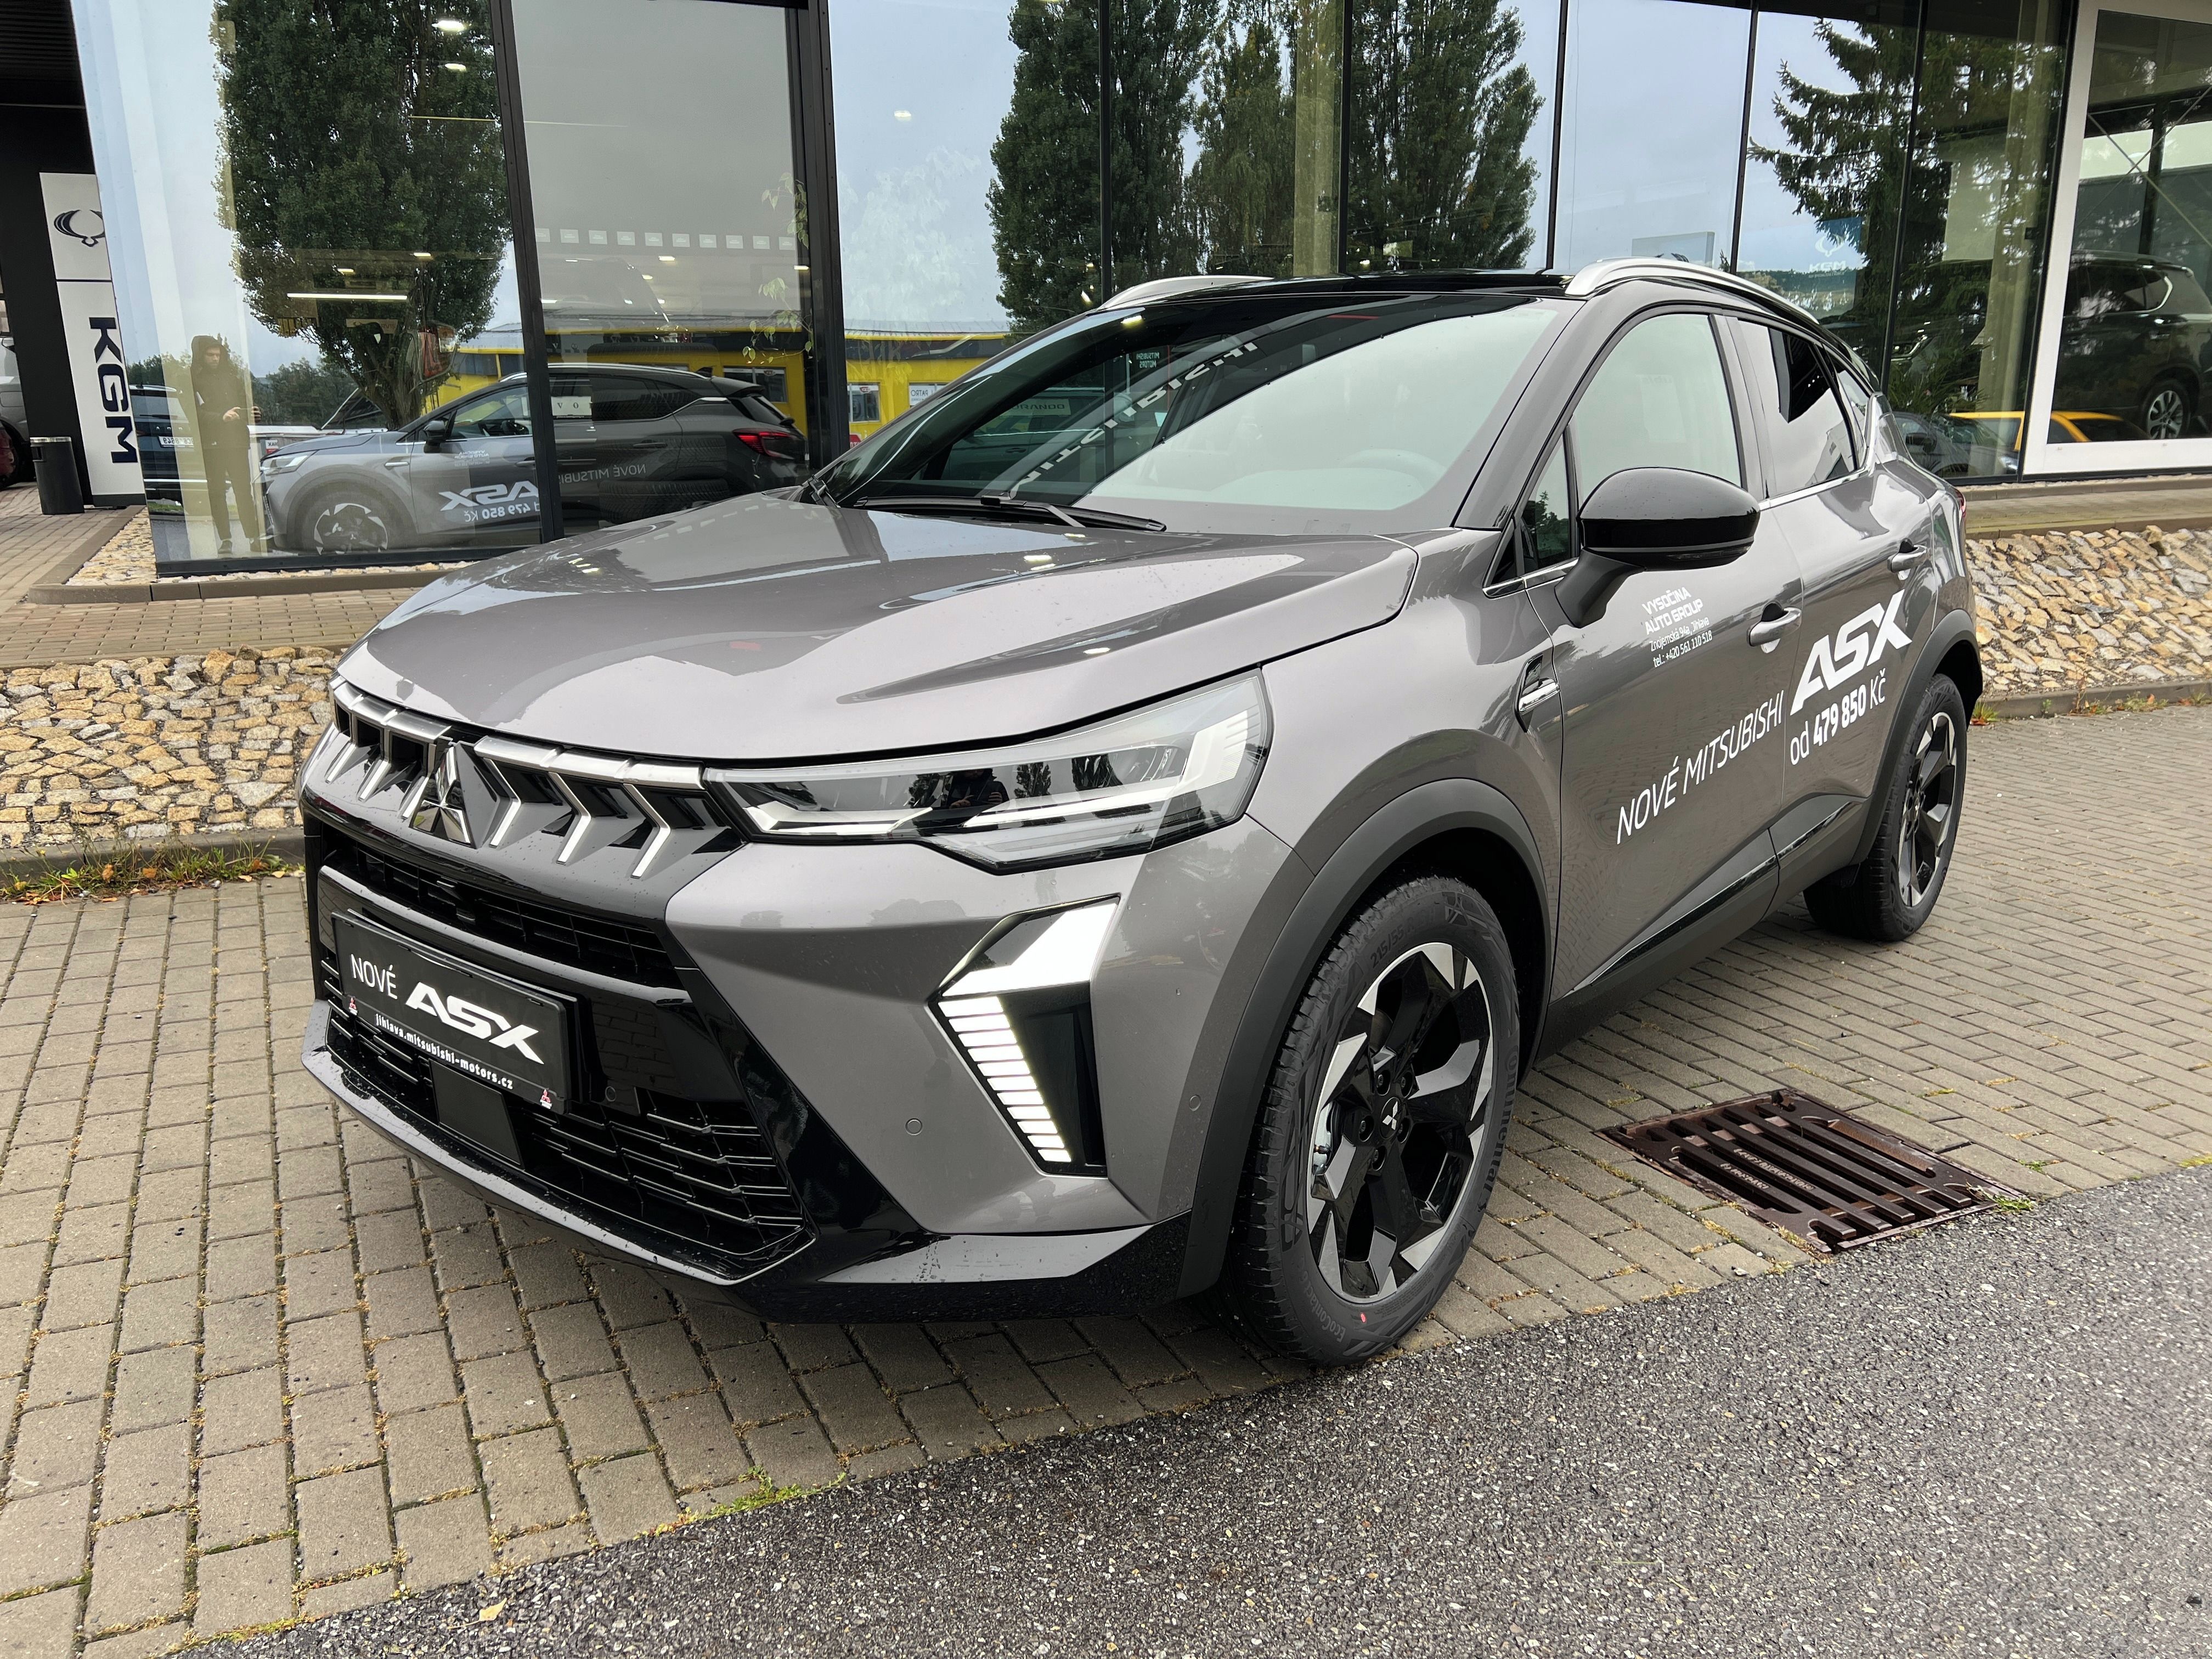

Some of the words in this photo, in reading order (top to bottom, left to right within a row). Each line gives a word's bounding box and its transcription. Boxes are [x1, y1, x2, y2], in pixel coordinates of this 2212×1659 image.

[1809, 260, 1846, 273] KGM
[89, 317, 138, 463] KGM
[1642, 587, 1691, 615] VYSOČINA
[1645, 613, 1672, 635] AUTO
[1671, 599, 1703, 622] GROUP
[1649, 628, 1679, 652] Znojemská
[1691, 617, 1709, 633] Jihlava
[1653, 653, 1666, 668] tel.:
[1666, 646, 1680, 660] +420
[1680, 640, 1691, 655] 561
[1691, 635, 1702, 649] 110
[1702, 630, 1713, 644] 518
[1617, 756, 1680, 845] NOVÉ
[1683, 690, 1784, 795] MITSUBISHI
[1790, 589, 1912, 716] ASX
[1790, 721, 1809, 765] od
[1813, 703, 1838, 747] 479
[1841, 684, 1866, 729] 850
[1870, 668, 1886, 709] Kč
[351, 953, 398, 1000] NOVÉ
[405, 981, 544, 1065] ASX
[375, 1013, 514, 1090] jihlava.mitsubishi-motors.cz
